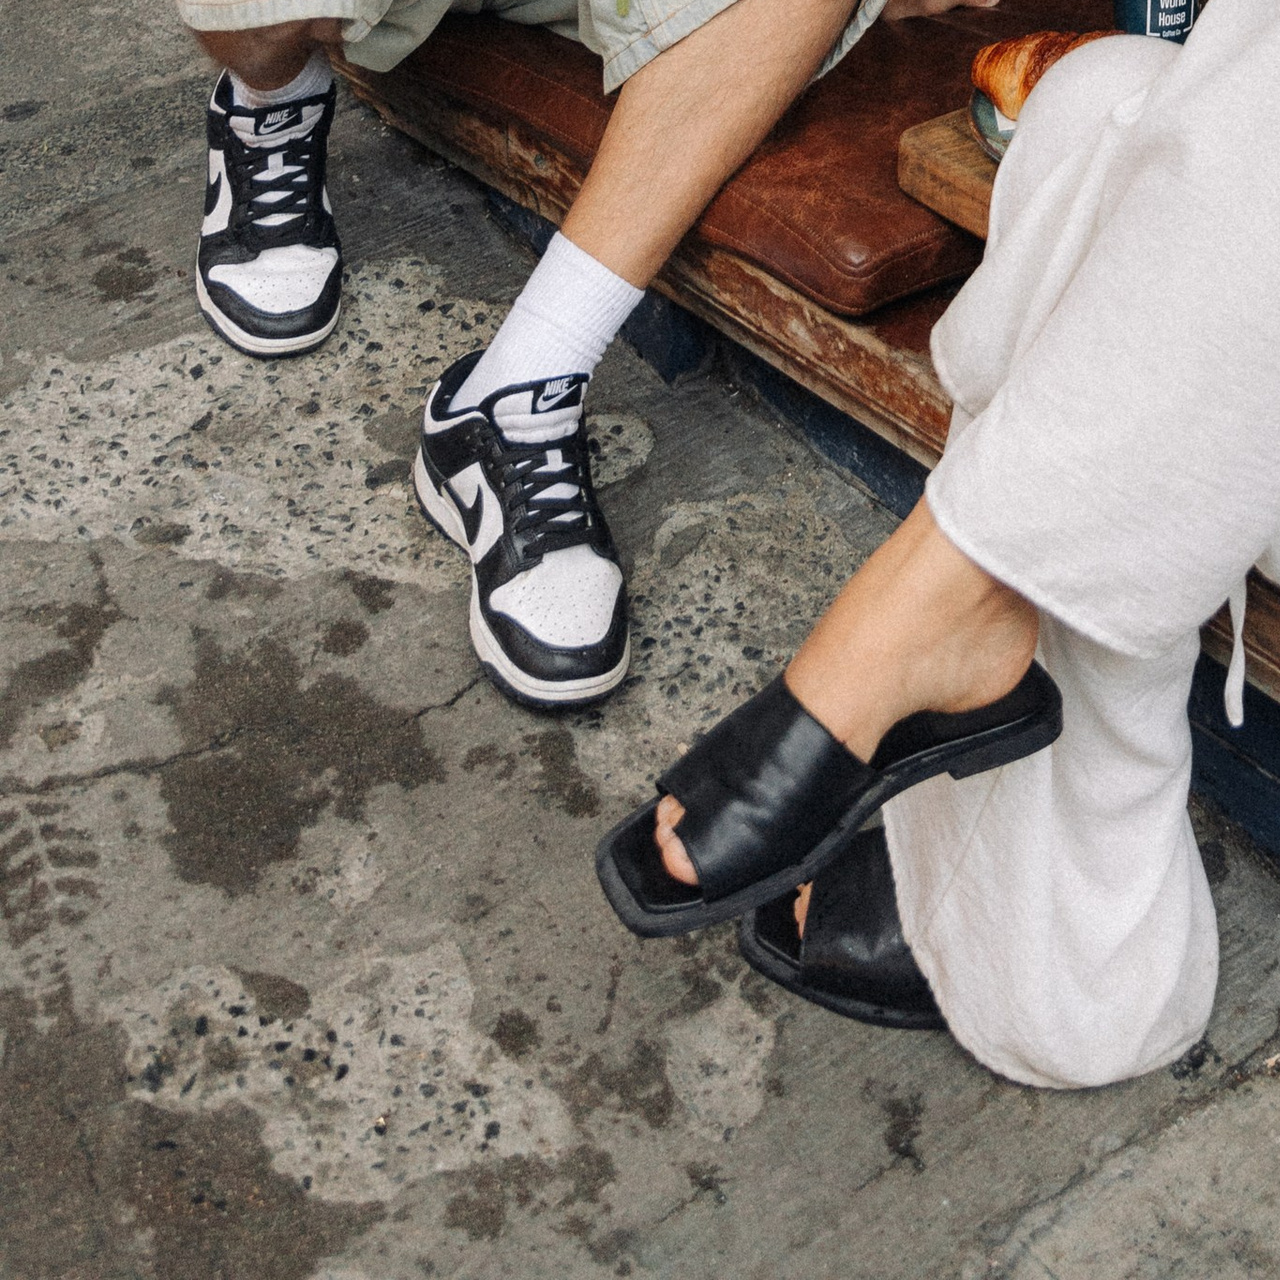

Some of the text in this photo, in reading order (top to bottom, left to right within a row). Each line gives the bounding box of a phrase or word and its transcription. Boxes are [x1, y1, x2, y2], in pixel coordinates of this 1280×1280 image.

[1158, 11, 1186, 27] House
[1162, 30, 1176, 38] Coffee
[264, 108, 290, 125] NIKE
[544, 377, 571, 397] NIKE
